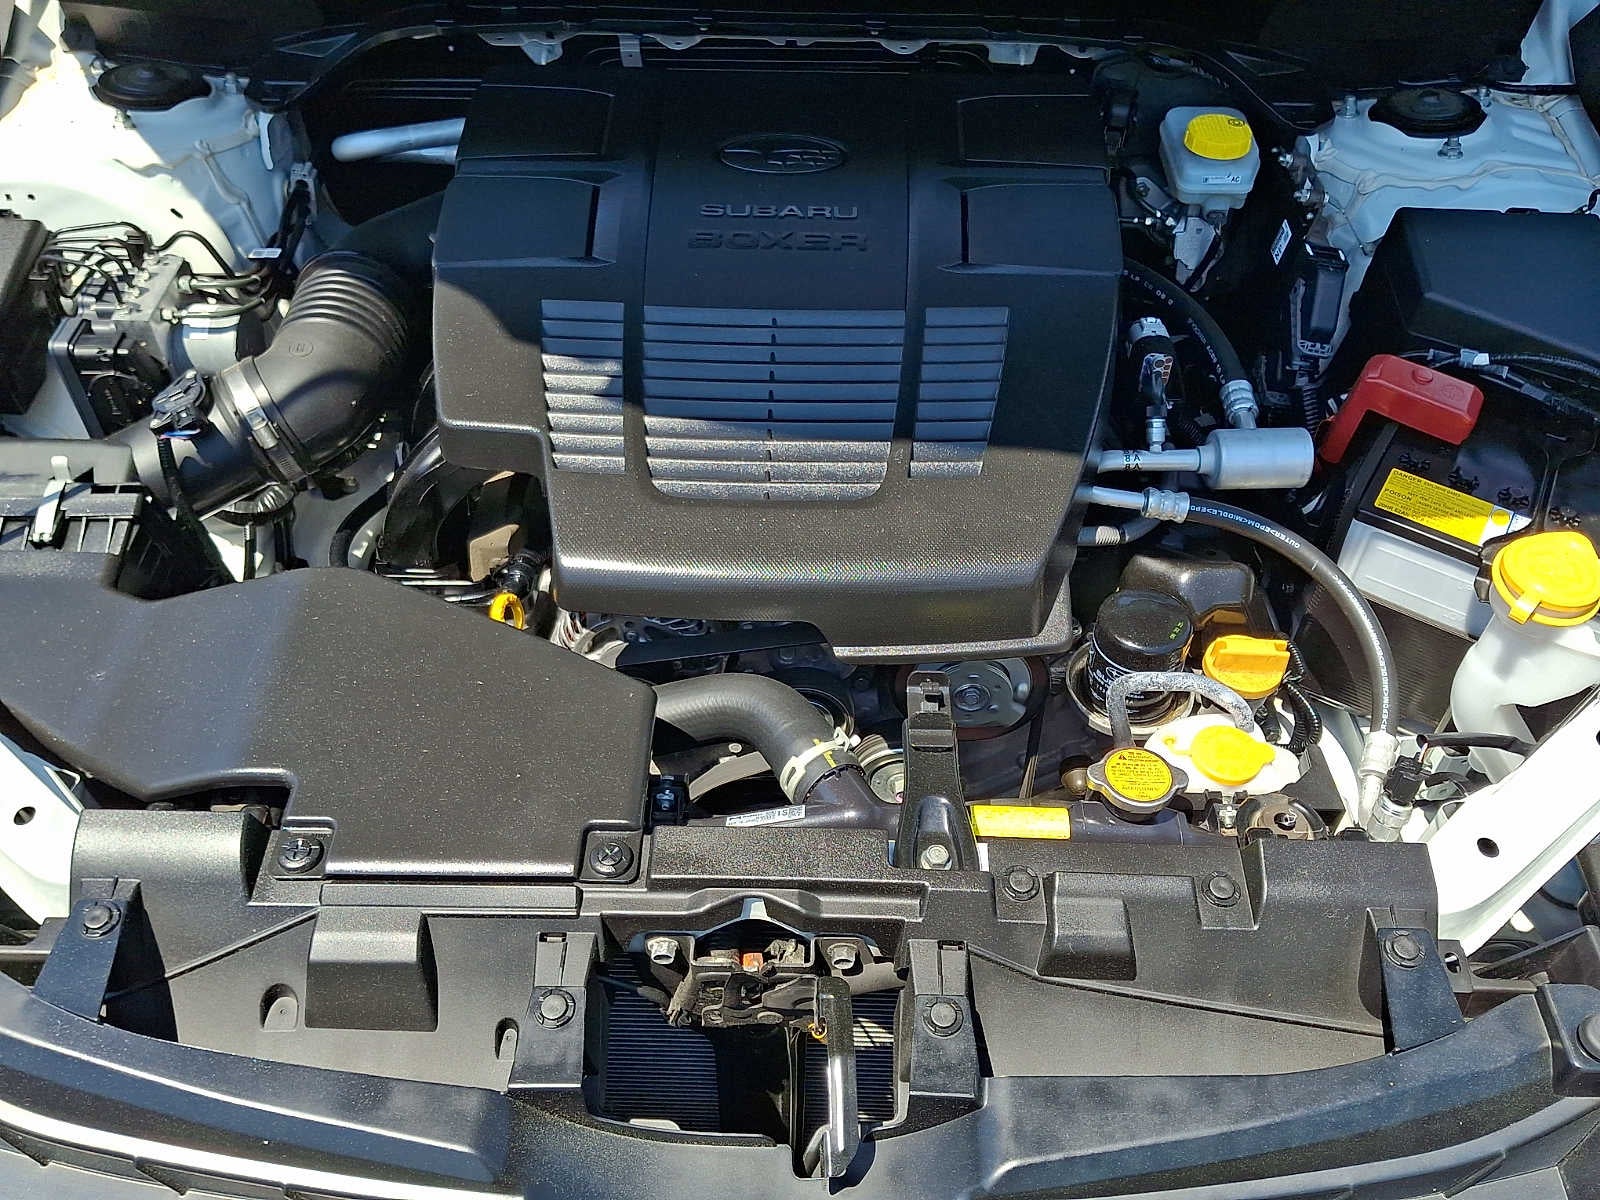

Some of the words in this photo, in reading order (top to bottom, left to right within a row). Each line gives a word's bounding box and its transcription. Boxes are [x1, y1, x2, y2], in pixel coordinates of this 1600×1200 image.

[700, 204, 858, 219] SUBARU
[687, 230, 867, 251] BOXER
[1393, 470, 1422, 483] DANGER
[1384, 488, 1412, 501] POISON
